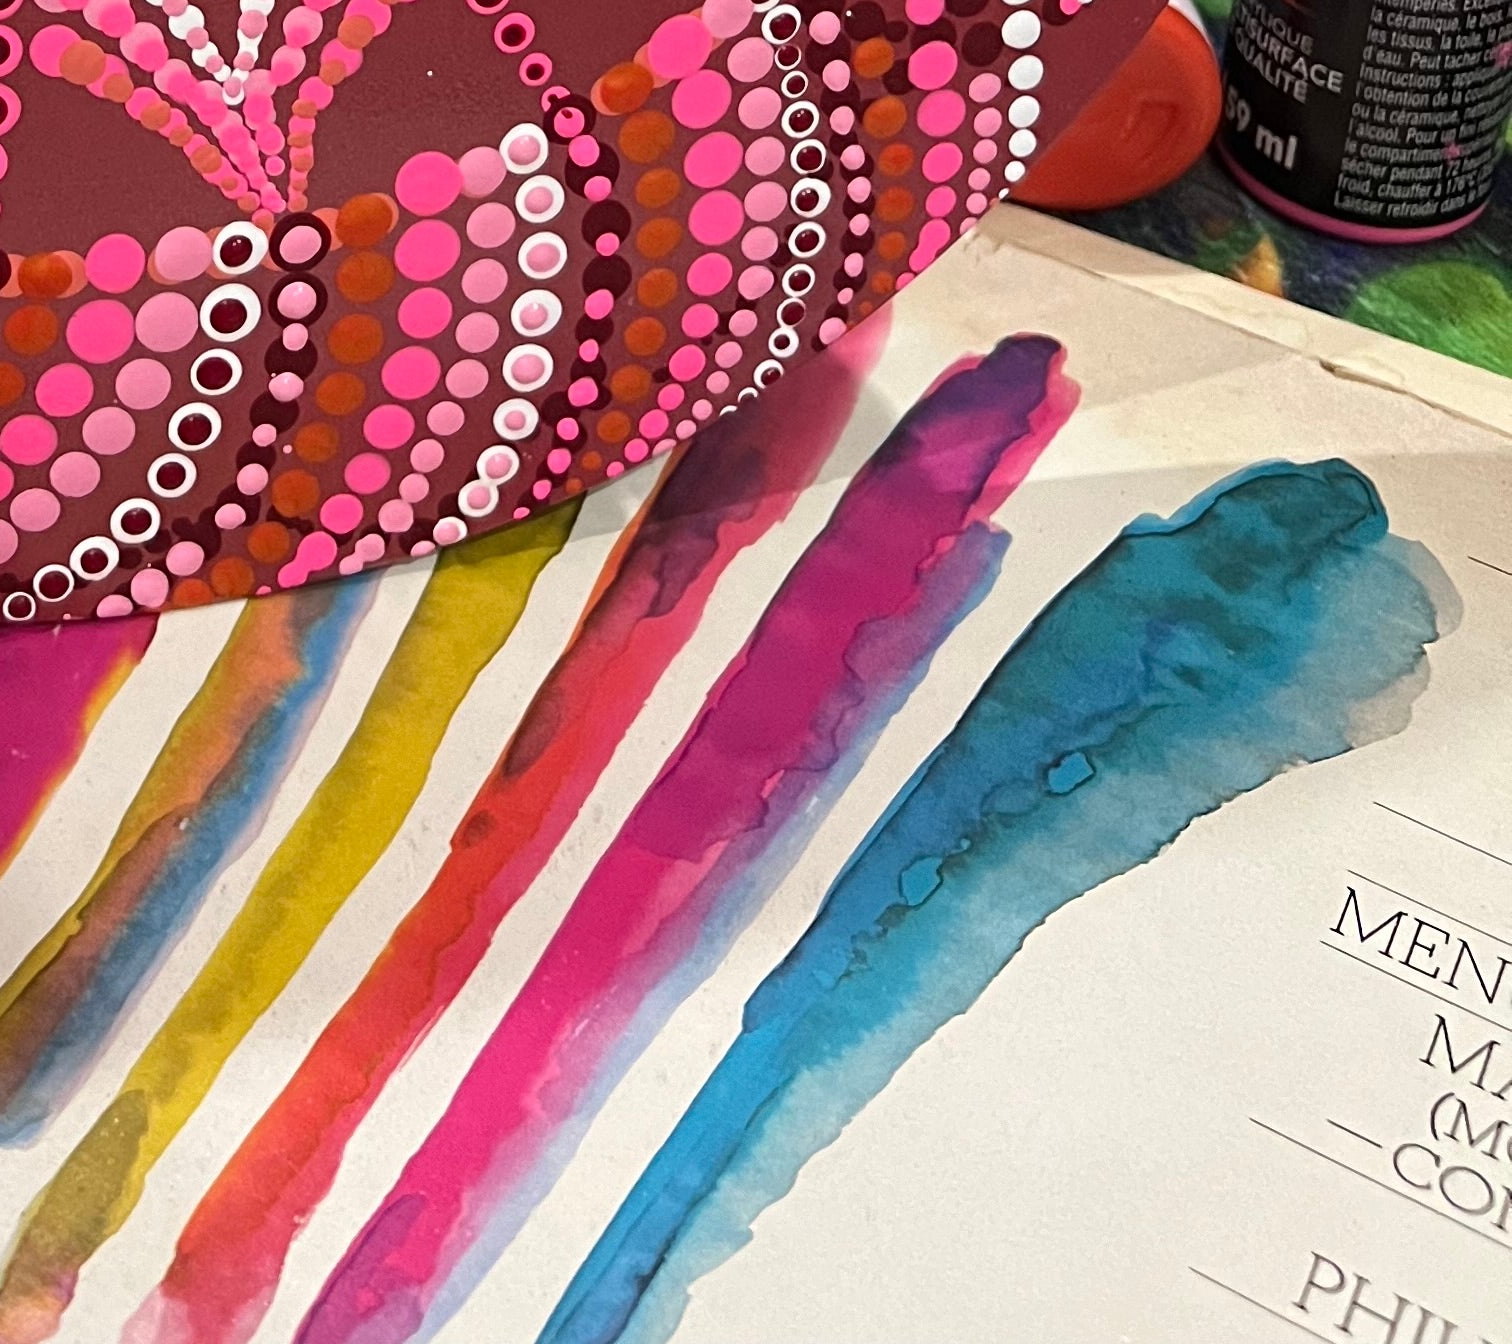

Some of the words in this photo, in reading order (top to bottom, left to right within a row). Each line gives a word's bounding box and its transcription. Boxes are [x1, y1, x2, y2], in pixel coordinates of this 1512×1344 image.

[1370, 5, 1384, 24] la
[1465, 12, 1477, 29] le
[1367, 24, 1387, 44] les
[1440, 32, 1453, 50] la
[1409, 51, 1441, 69] Peut
[1359, 62, 1441, 89] Instructions
[1431, 91, 1449, 106] de
[1351, 102, 1371, 117] ou
[1373, 105, 1387, 122] la
[1254, 124, 1298, 171] ml
[1406, 127, 1437, 144] Pour
[1329, 885, 1512, 1004] MEN
